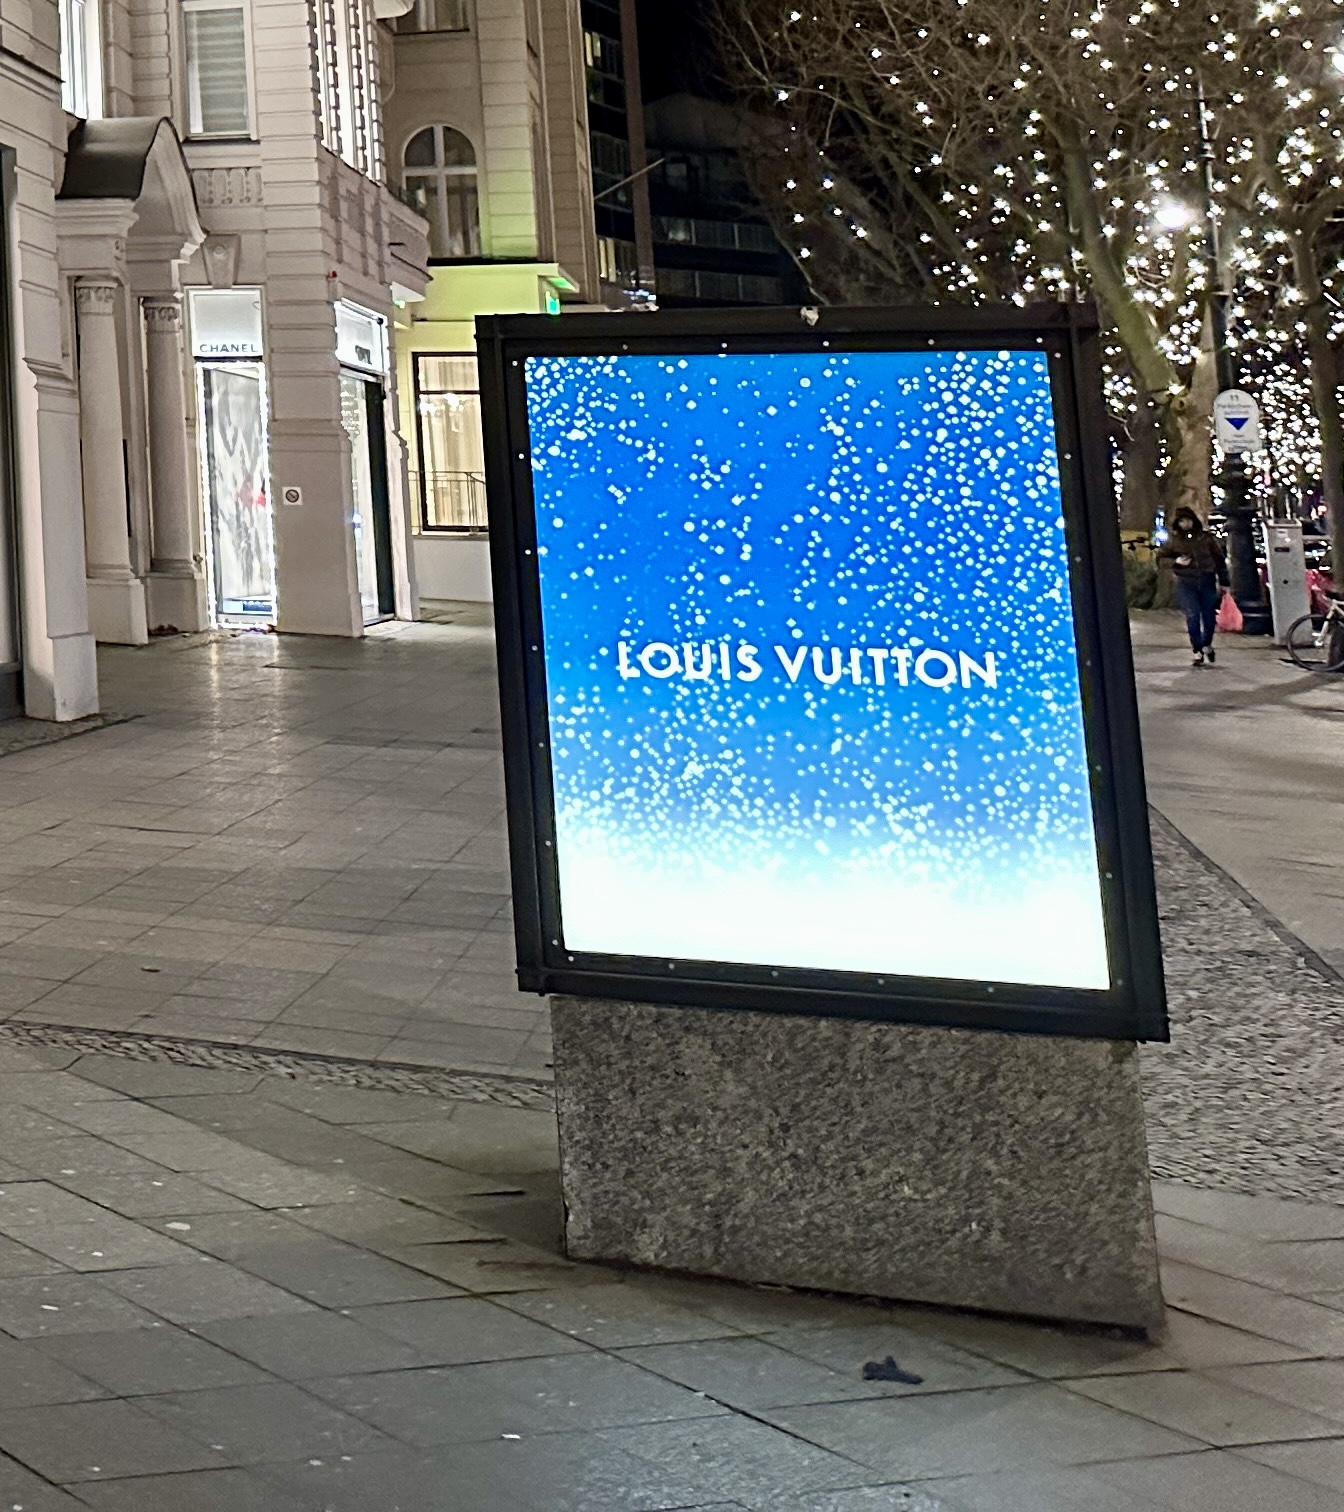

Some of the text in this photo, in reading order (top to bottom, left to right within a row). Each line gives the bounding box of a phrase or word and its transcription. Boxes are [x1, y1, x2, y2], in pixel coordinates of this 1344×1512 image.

[199, 343, 259, 353] CHANEL
[617, 641, 998, 689] LOUIS VUITTON
